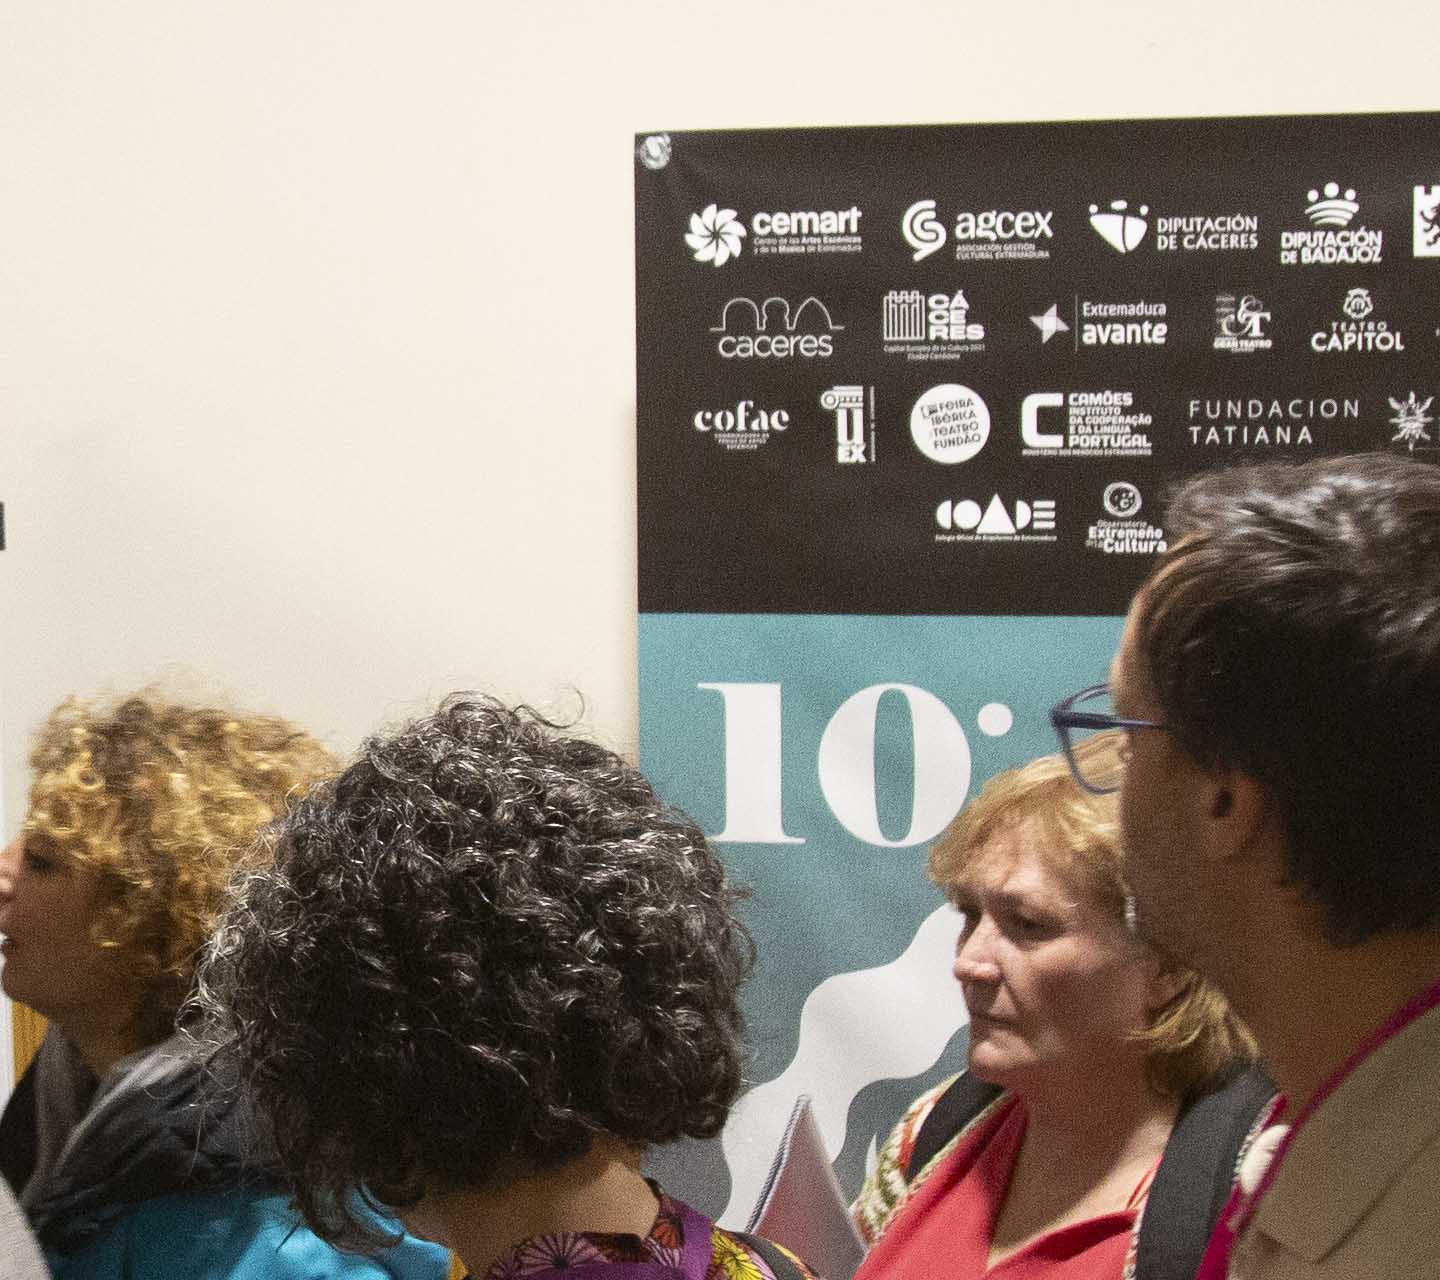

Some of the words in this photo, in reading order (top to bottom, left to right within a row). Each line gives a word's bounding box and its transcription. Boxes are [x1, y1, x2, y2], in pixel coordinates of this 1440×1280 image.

[752, 206, 862, 236] cemart
[955, 210, 1053, 241] agcex
[1157, 214, 1258, 233] DIPUTACIÓN
[1158, 234, 1177, 250] DE
[1184, 230, 1258, 249] CÁCERES
[1281, 226, 1382, 248] DIPUTACIÓN
[1281, 251, 1297, 264] DE
[1301, 246, 1382, 263] BADAJOZ
[1082, 300, 1166, 317] Extremadura
[929, 324, 985, 340] RES
[1082, 321, 1167, 345] avante
[1332, 321, 1388, 332] TEATRO
[1310, 331, 1405, 352] CAPITOL
[1068, 390, 1133, 406] CAMÕES
[694, 400, 790, 431] cofae
[1069, 406, 1121, 416] INSTITUTO
[1069, 415, 1083, 425] DA
[1085, 412, 1152, 427] COOPERAÇÃO
[1078, 425, 1092, 434] DA
[1189, 425, 1313, 445] TATIANA
[1068, 434, 1152, 448] PORTUGAL
[1088, 525, 1163, 539] Extremeño
[1103, 537, 1168, 554] Cultura
